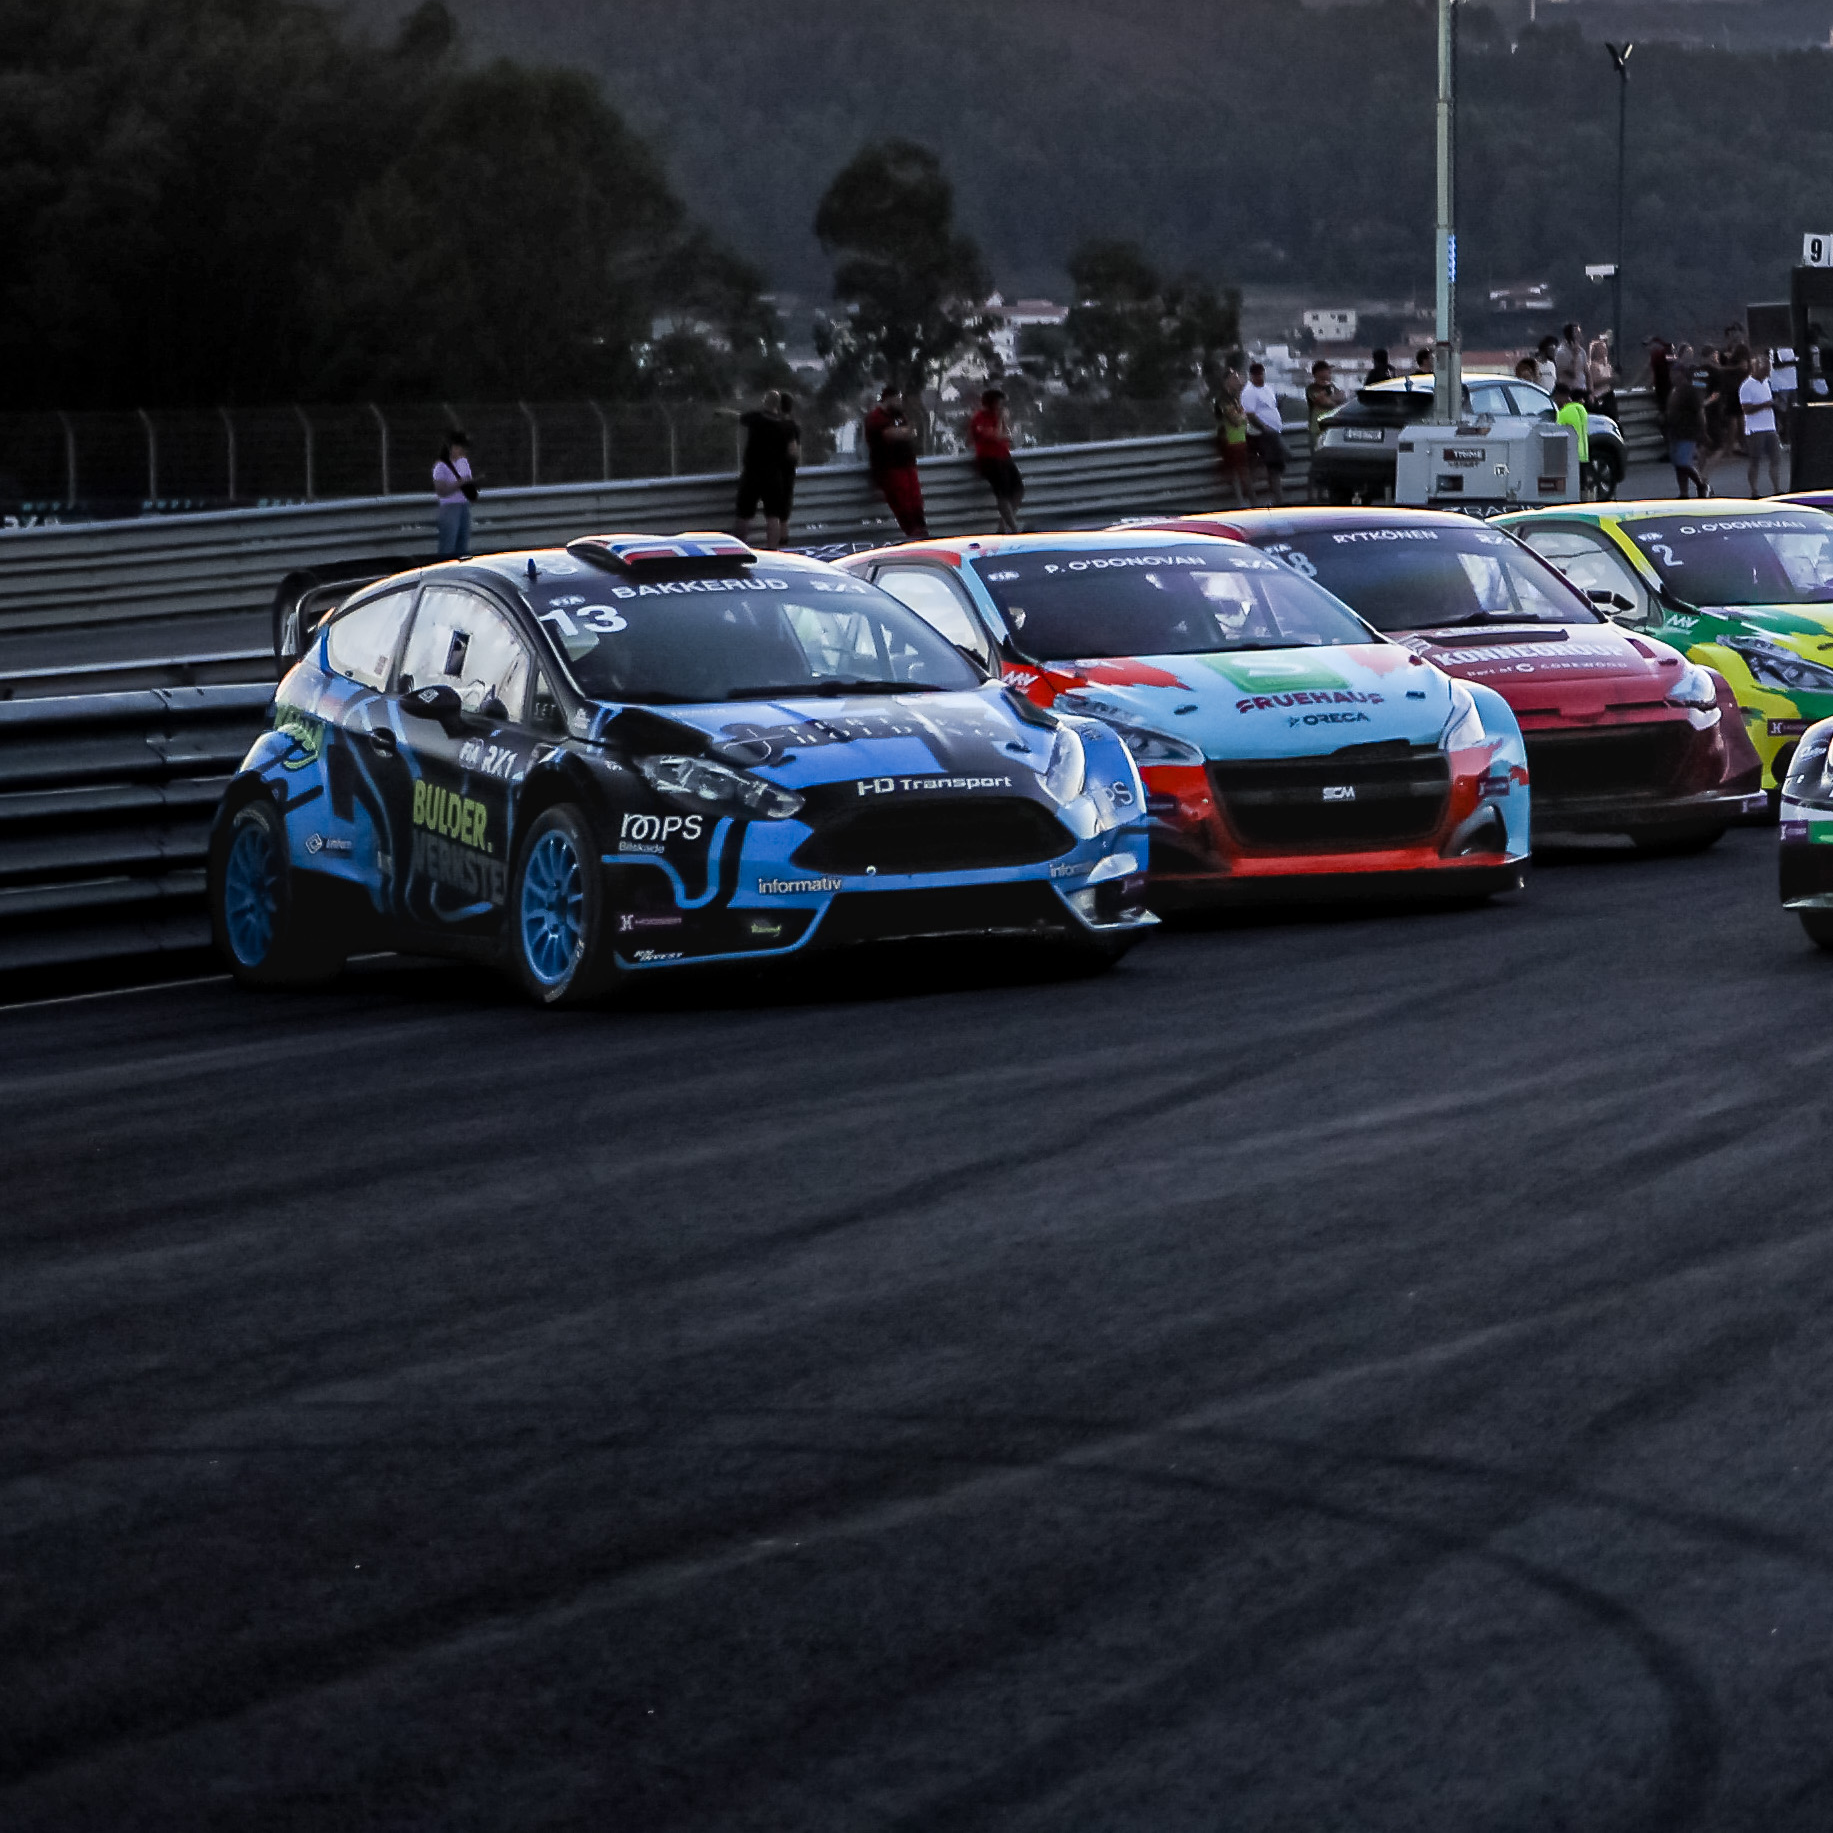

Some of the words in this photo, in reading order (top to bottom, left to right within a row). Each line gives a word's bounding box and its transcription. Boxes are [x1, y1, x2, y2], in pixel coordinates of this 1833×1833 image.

[1652, 543, 1684, 568] 2
[611, 576, 789, 600] BAKKERUD
[539, 604, 628, 637] 13
[899, 776, 1013, 793] Transport
[758, 877, 843, 895] informativ
